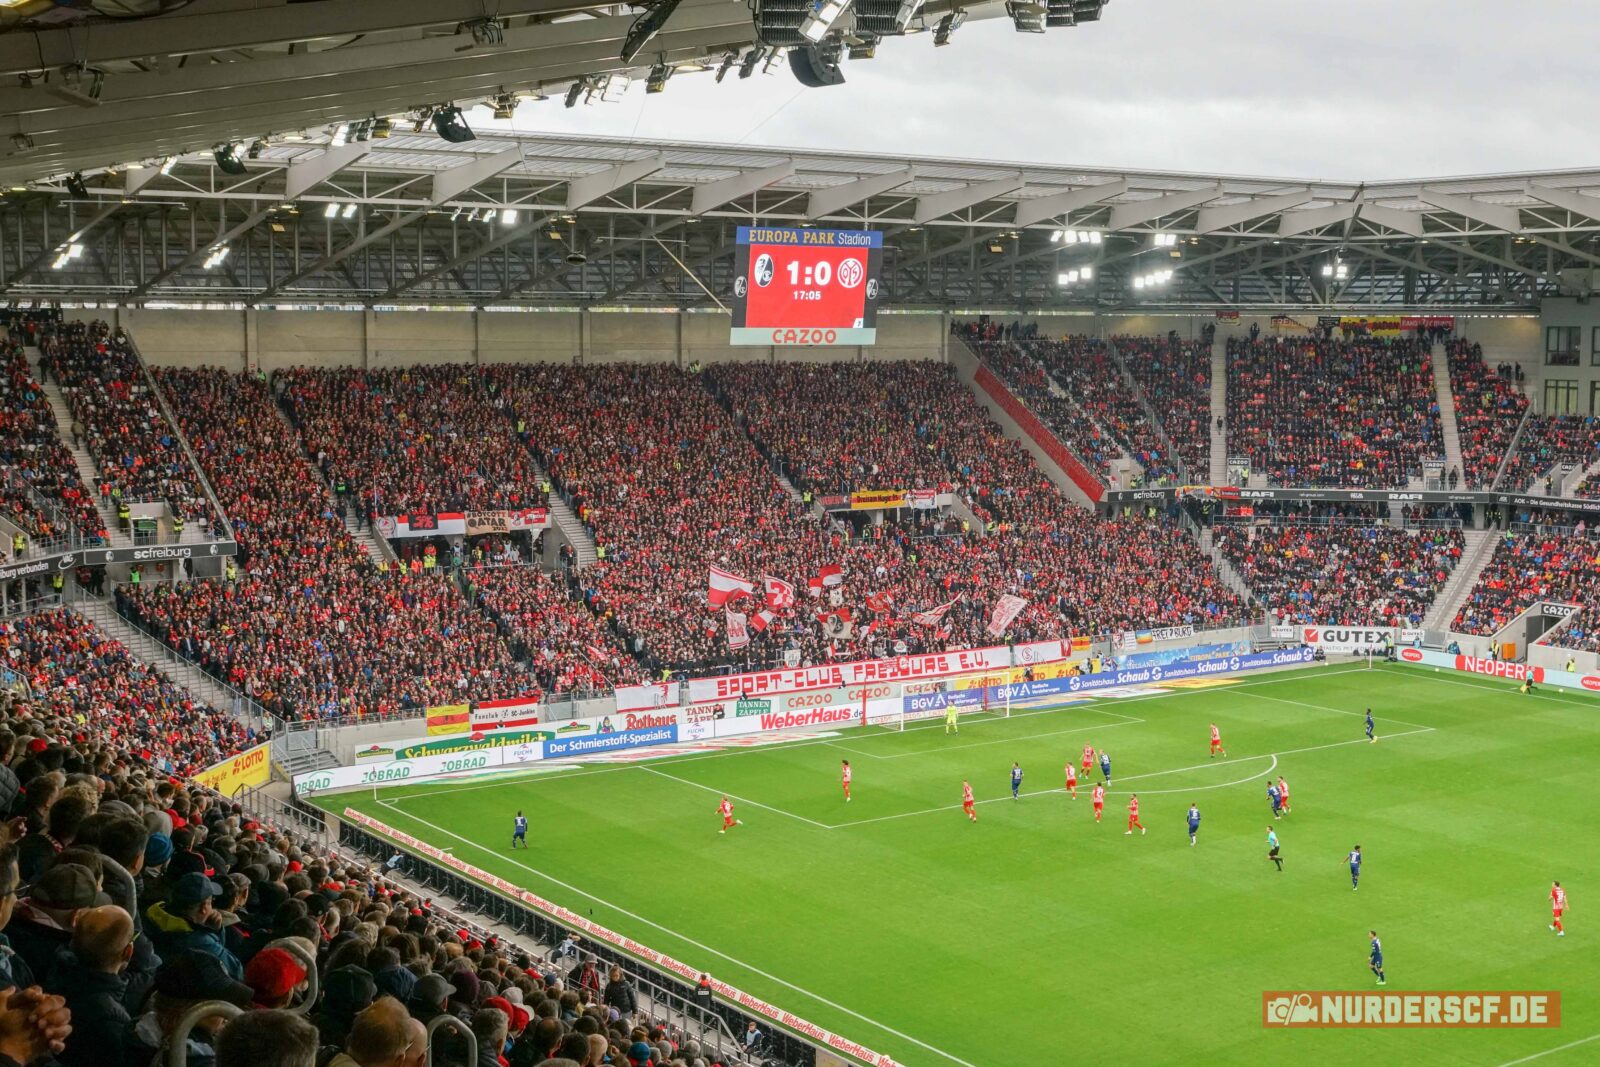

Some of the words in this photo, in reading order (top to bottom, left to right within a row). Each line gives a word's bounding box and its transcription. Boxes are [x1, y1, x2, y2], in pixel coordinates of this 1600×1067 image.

[749, 230, 798, 243] EUROPA
[803, 232, 834, 244] PARK
[838, 232, 871, 246] Stadion
[787, 260, 832, 286] 1:0
[793, 291, 821, 300] 17:05
[772, 329, 837, 344] CAZOO
[1539, 500, 1582, 509] Gesundheitskasse
[467, 510, 507, 519] #BOYCOTT
[467, 517, 506, 528] QATAR
[17, 560, 49, 576] verbunden
[1323, 629, 1389, 644] GUTEX
[1273, 651, 1302, 664] Schaub
[1197, 660, 1228, 673] Schaub
[1464, 655, 1530, 680] NEOPER
[717, 667, 843, 697] SPORT-CLUB
[1117, 671, 1150, 684] Schaub
[787, 693, 832, 708] CAZOO
[625, 712, 677, 731] Rothaus
[550, 742, 567, 754] Der
[569, 730, 672, 750] Schmierstoff-Spezialist
[242, 750, 264, 770] LOTTO
[440, 756, 487, 772] JOBRAD
[361, 766, 411, 784] JOBRAD
[296, 777, 331, 795] OBRAD
[623, 938, 658, 962] WeberHaus
[661, 955, 697, 980] WeberHaus
[738, 992, 780, 1020] WeberHaus
[781, 1012, 825, 1042] WeberHaus
[828, 1033, 876, 1063] WeberHaus
